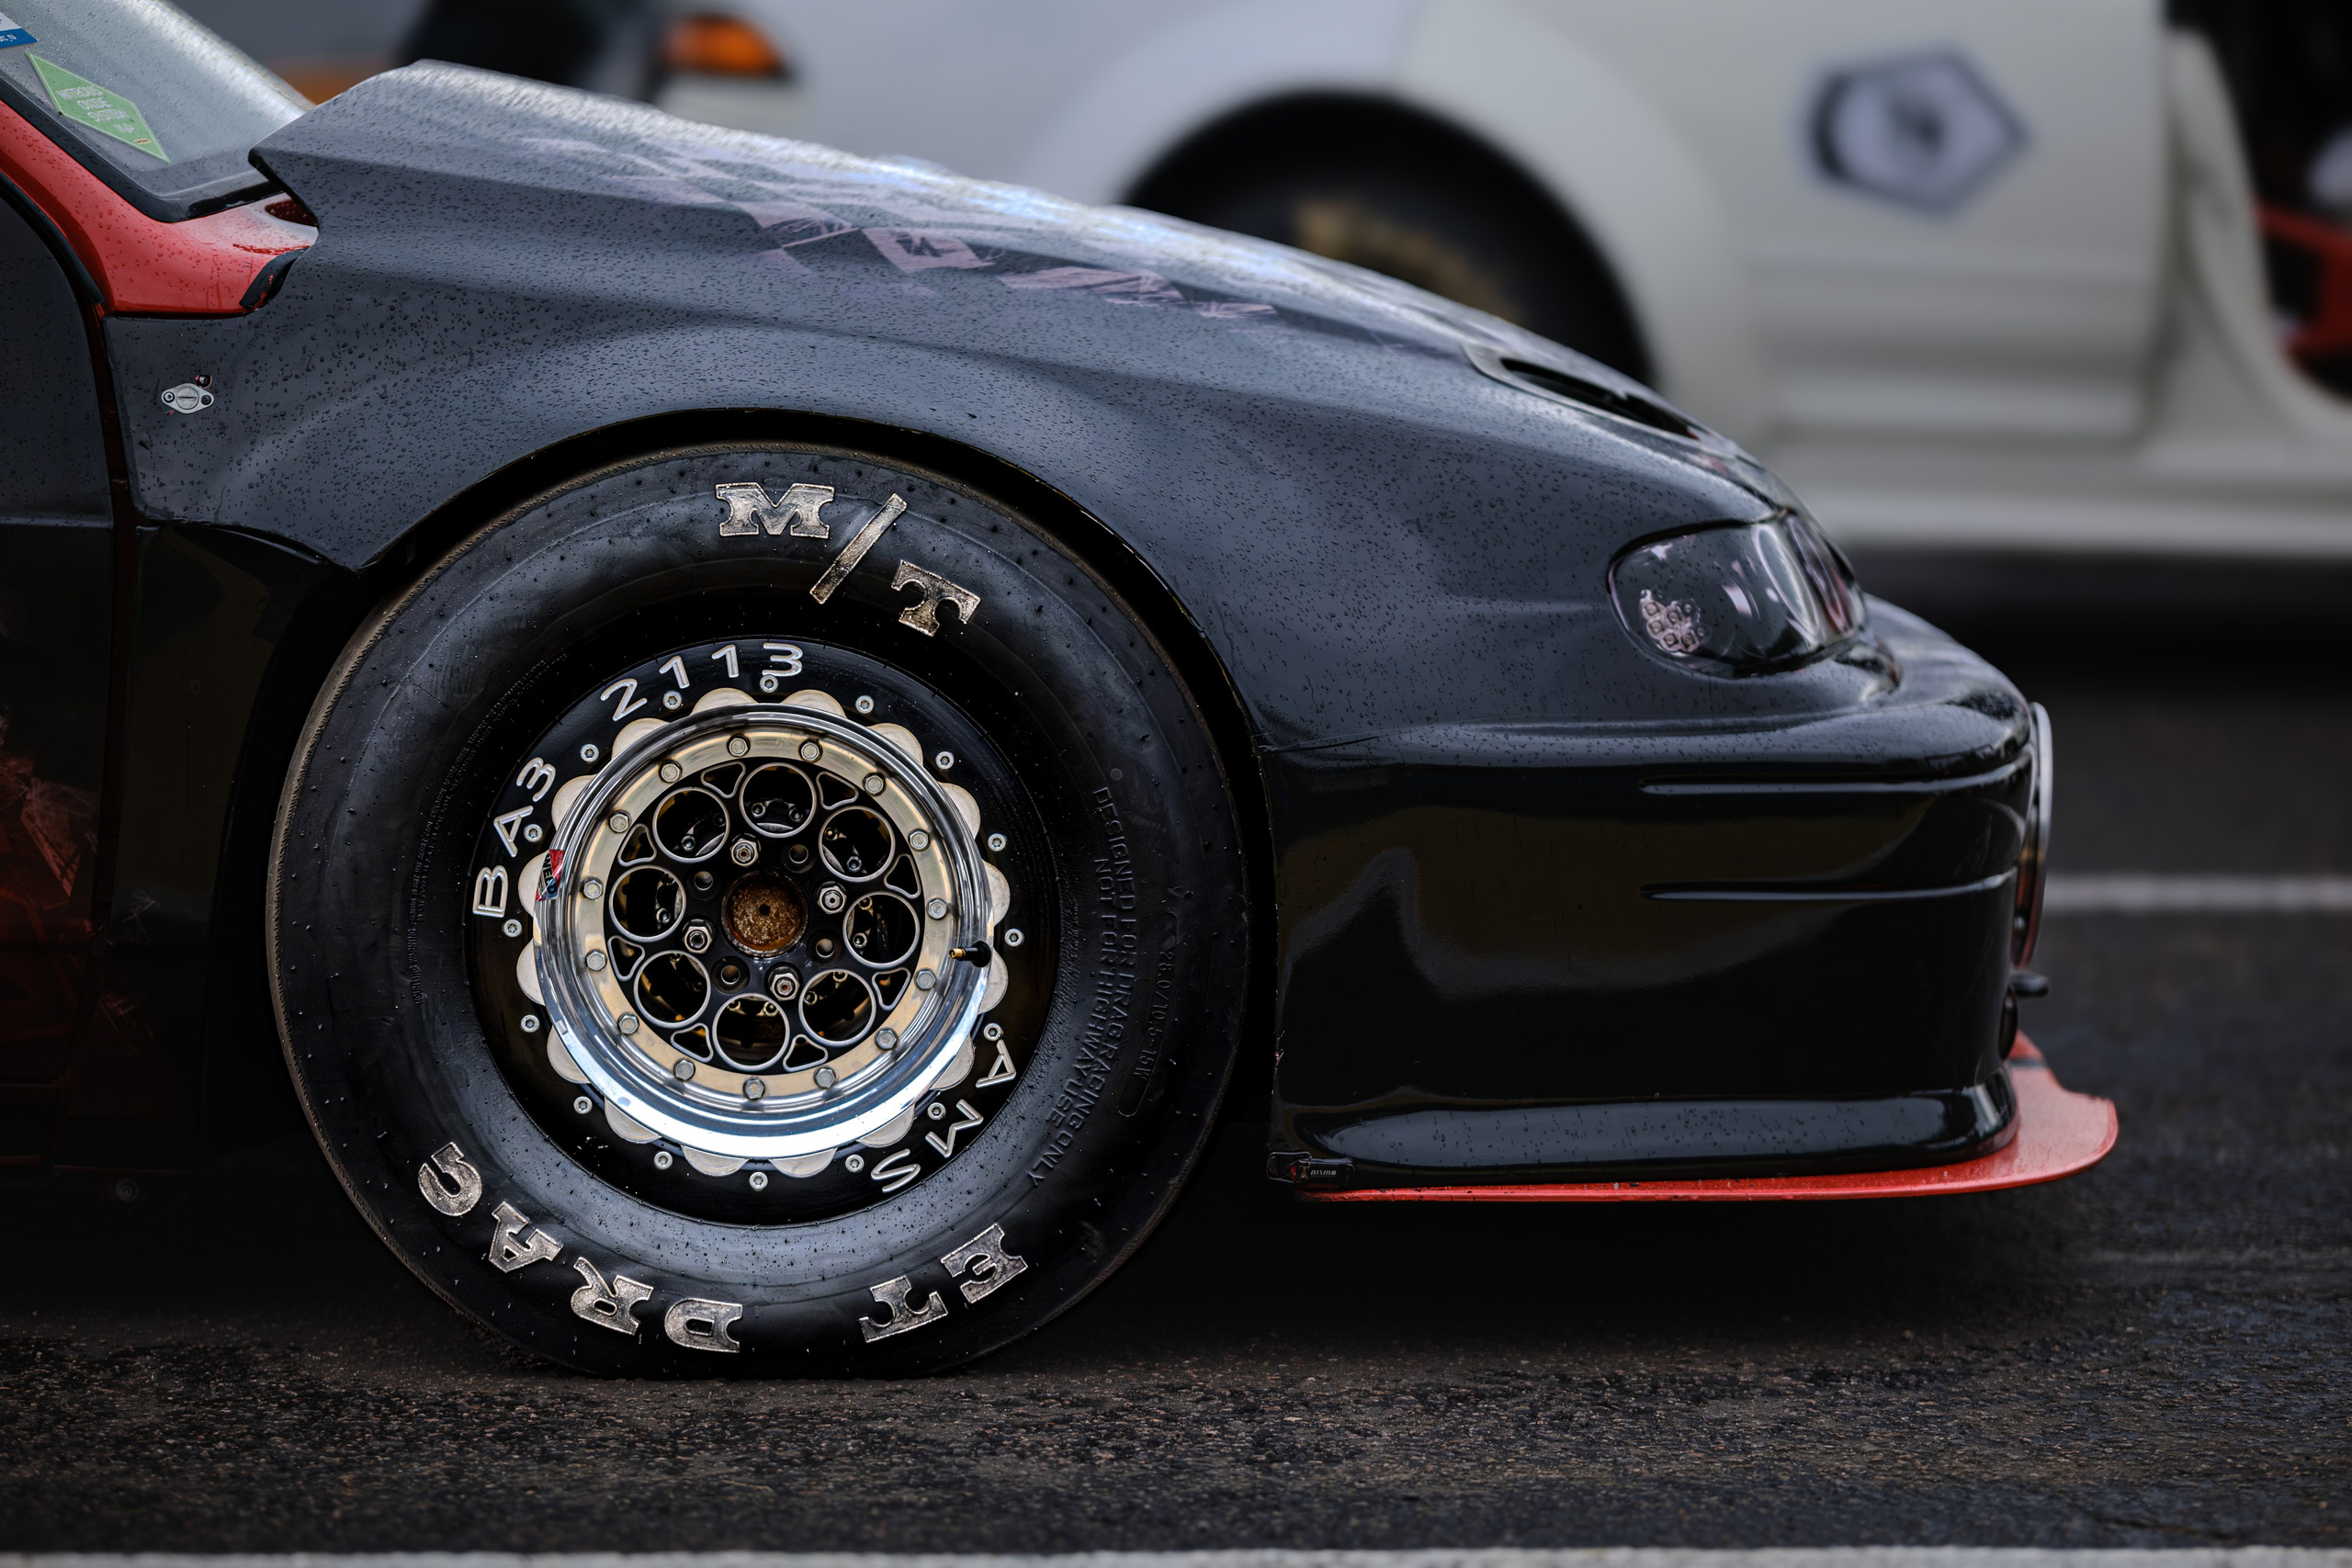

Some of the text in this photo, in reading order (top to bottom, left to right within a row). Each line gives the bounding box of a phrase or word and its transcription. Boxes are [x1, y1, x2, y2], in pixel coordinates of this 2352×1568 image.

[56, 85, 104, 100] NITROUS
[77, 97, 113, 110] OXIDE
[87, 108, 130, 122] SYSTEM
[472, 756, 557, 918] BA3
[600, 643, 803, 722] 2113
[1025, 787, 1138, 1188] DESIGNED FOR DRAG RACING ONLY
[1046, 858, 1118, 1128] NOT FOR HIGHWAY USE
[870, 1039, 1017, 1193] AMS
[417, 1142, 1028, 1353] ET DRAG
